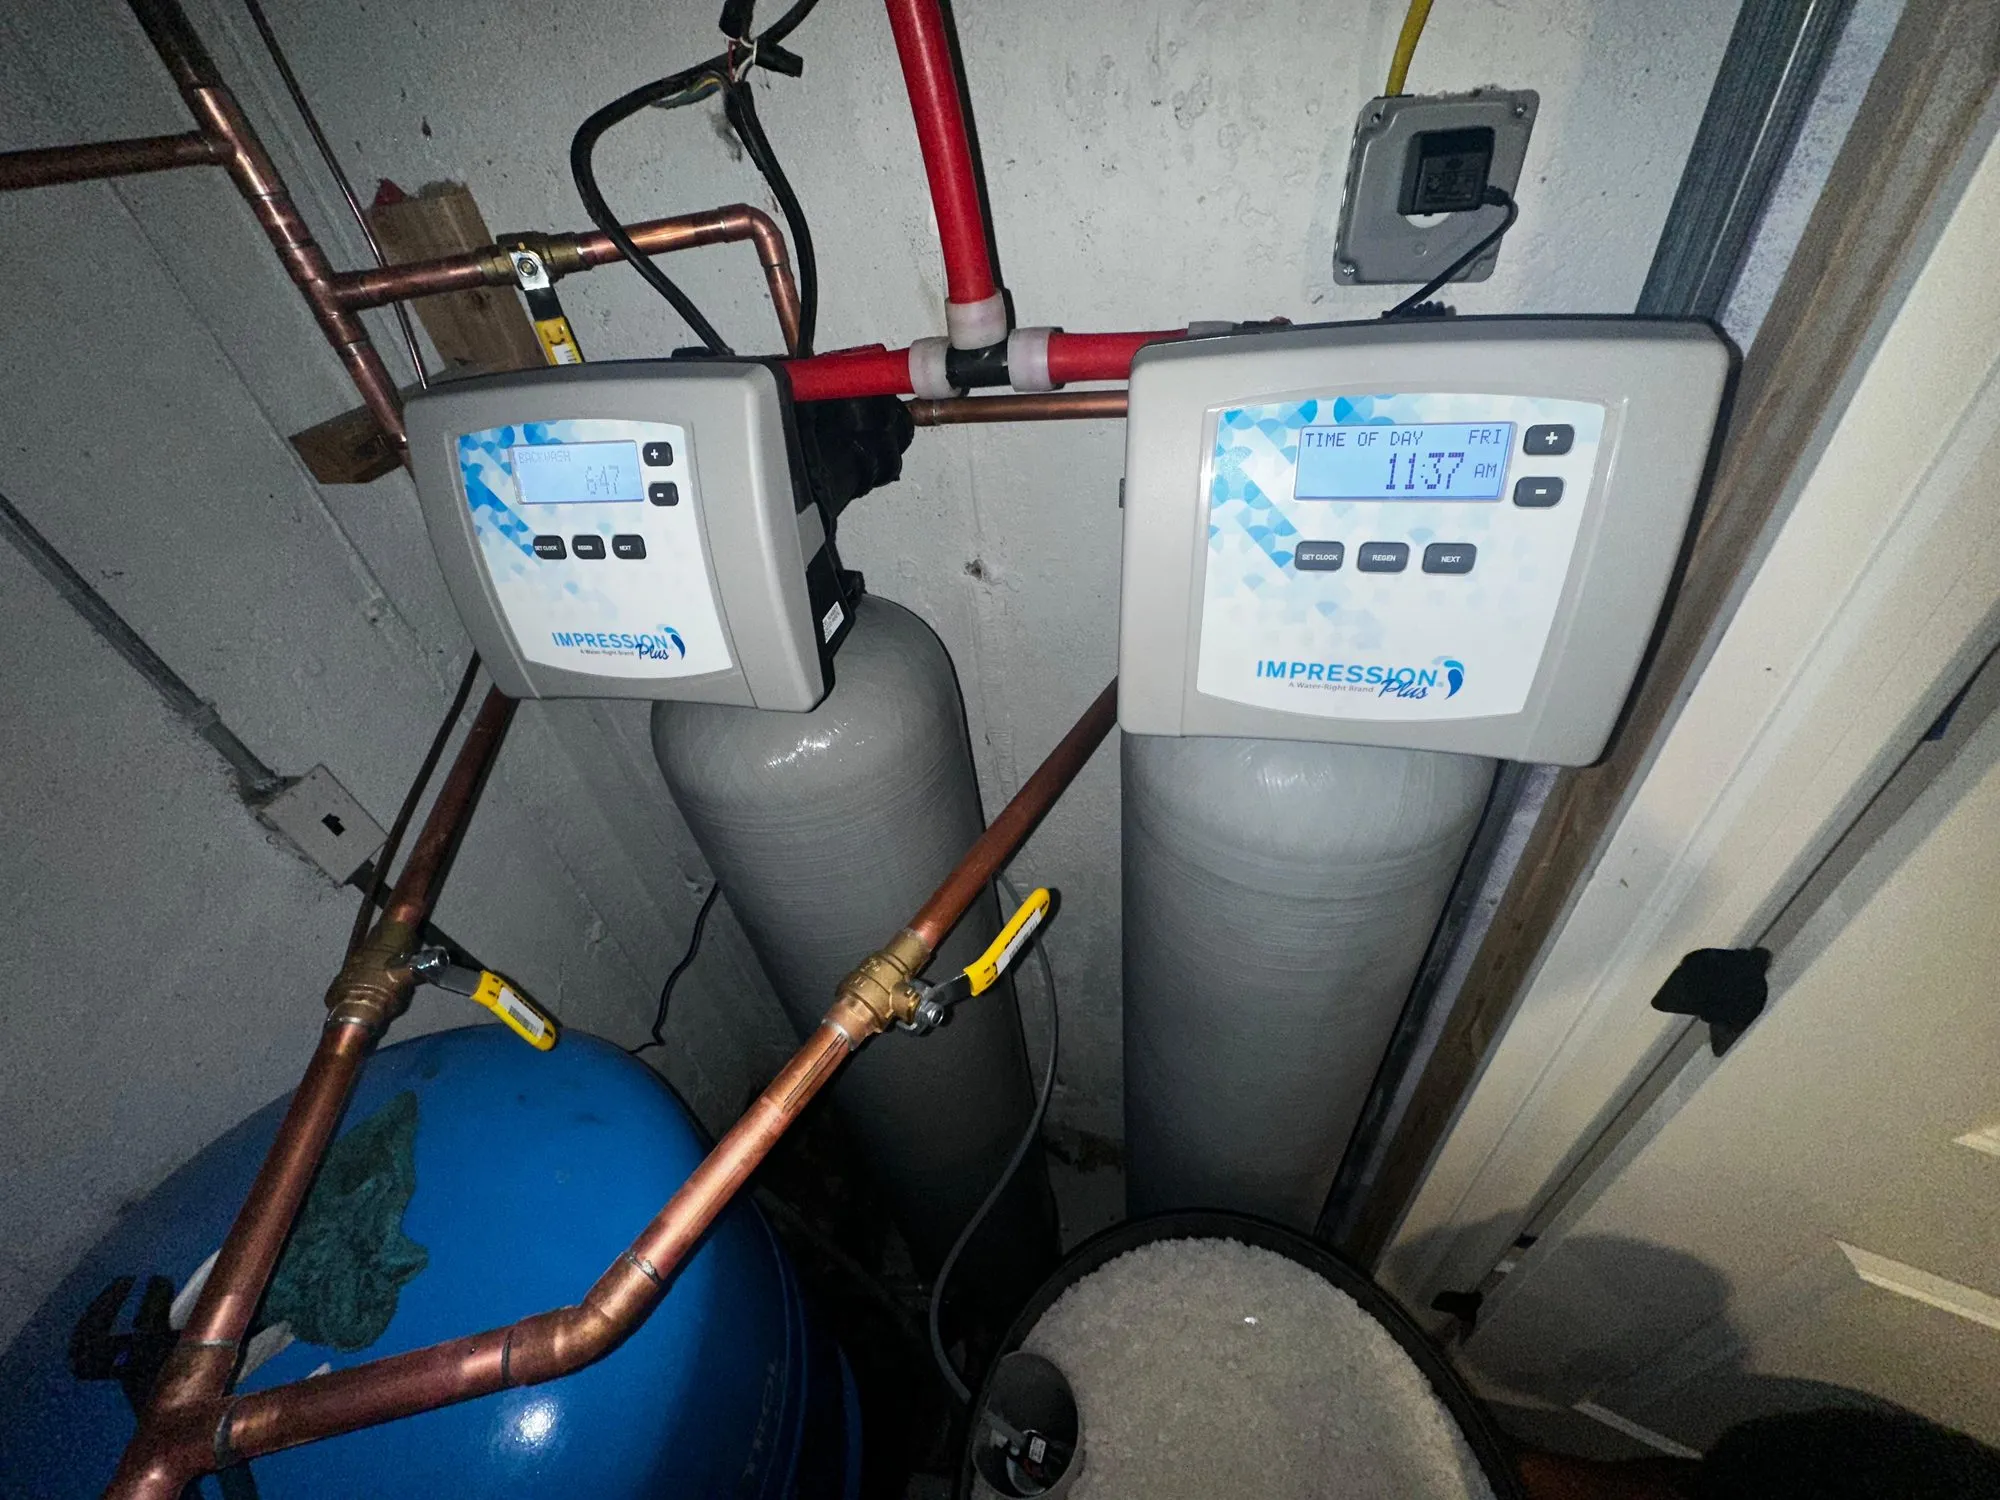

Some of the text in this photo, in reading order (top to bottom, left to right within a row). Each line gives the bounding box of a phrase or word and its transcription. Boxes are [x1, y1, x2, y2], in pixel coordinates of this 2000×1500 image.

[1305, 429, 1502, 448] TIME OF DAY FRI
[518, 450, 571, 464] BACKWASH
[1385, 452, 1498, 490] 11:37 AM
[1301, 553, 1338, 561] SET CLOCK
[1372, 554, 1397, 562] REGEN
[1441, 555, 1462, 563] NEXT
[551, 632, 669, 650] IMPRESSION
[635, 643, 669, 660] Plus
[1256, 660, 1438, 687] IMPRESSION
[1296, 682, 1346, 692] Water-Right
[1348, 684, 1375, 693] Brand
[1378, 678, 1429, 700] Plus
